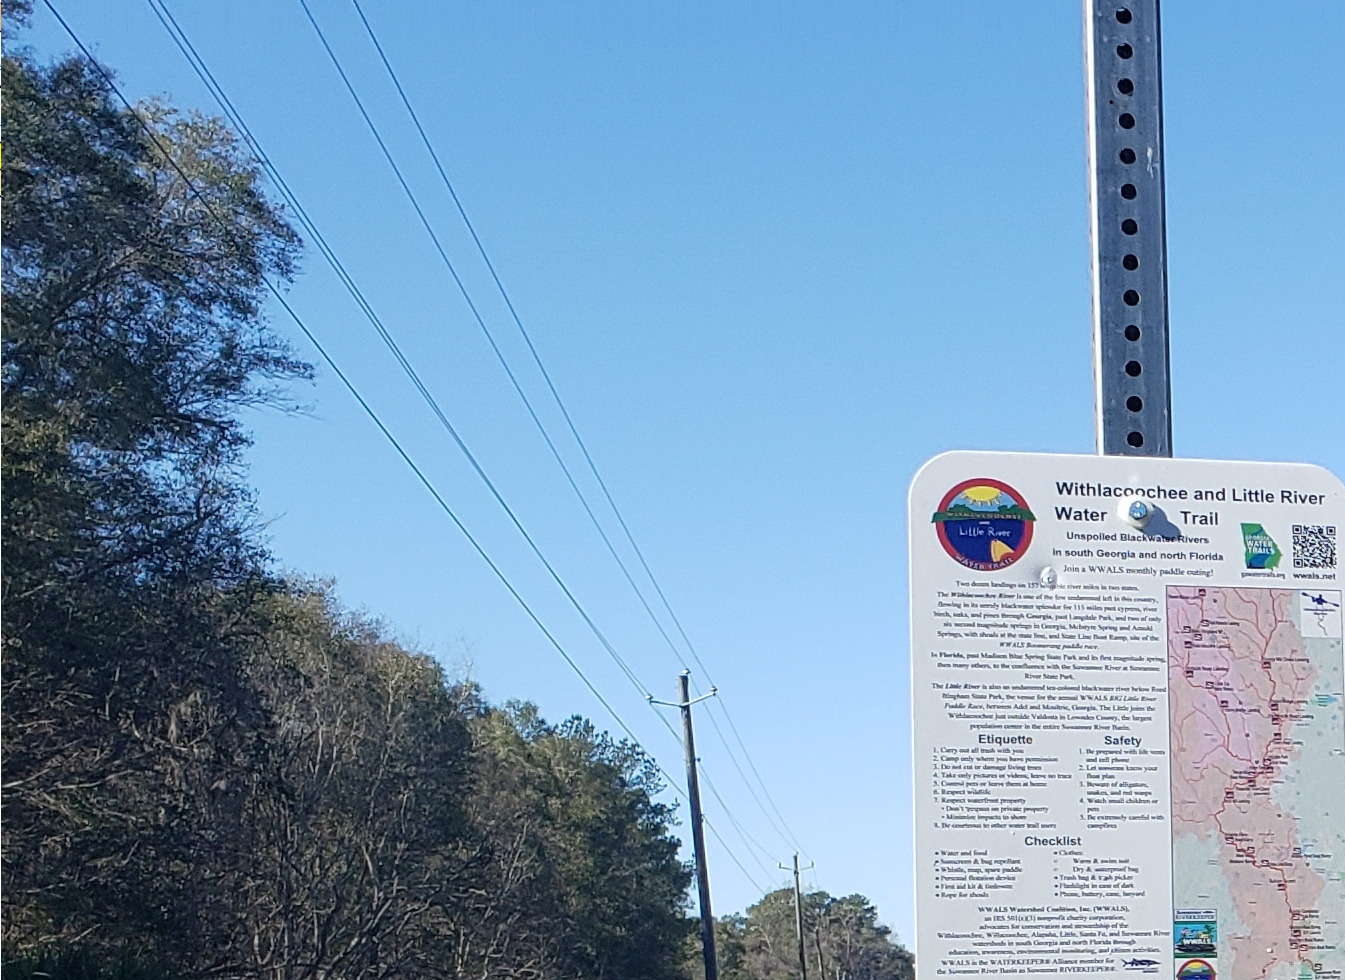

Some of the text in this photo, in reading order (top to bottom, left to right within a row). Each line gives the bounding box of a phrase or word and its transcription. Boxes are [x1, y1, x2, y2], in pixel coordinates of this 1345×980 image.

[1055, 482, 1325, 504] Withlacoochee and Little River
[1055, 506, 1219, 526] Water Trail
[959, 526, 1011, 537] Little River
[1066, 532, 1210, 544] Unspoiled Blackwater Rivers
[1246, 540, 1274, 548] WATER
[1064, 549, 1093, 557] south
[1096, 549, 1135, 558] Georgia
[1189, 552, 1223, 560] Florida
[1248, 547, 1276, 555] TRAILS
[978, 734, 1033, 746] Etiquette
[1104, 736, 1142, 747] Safety
[1024, 836, 1082, 846] Checklist
